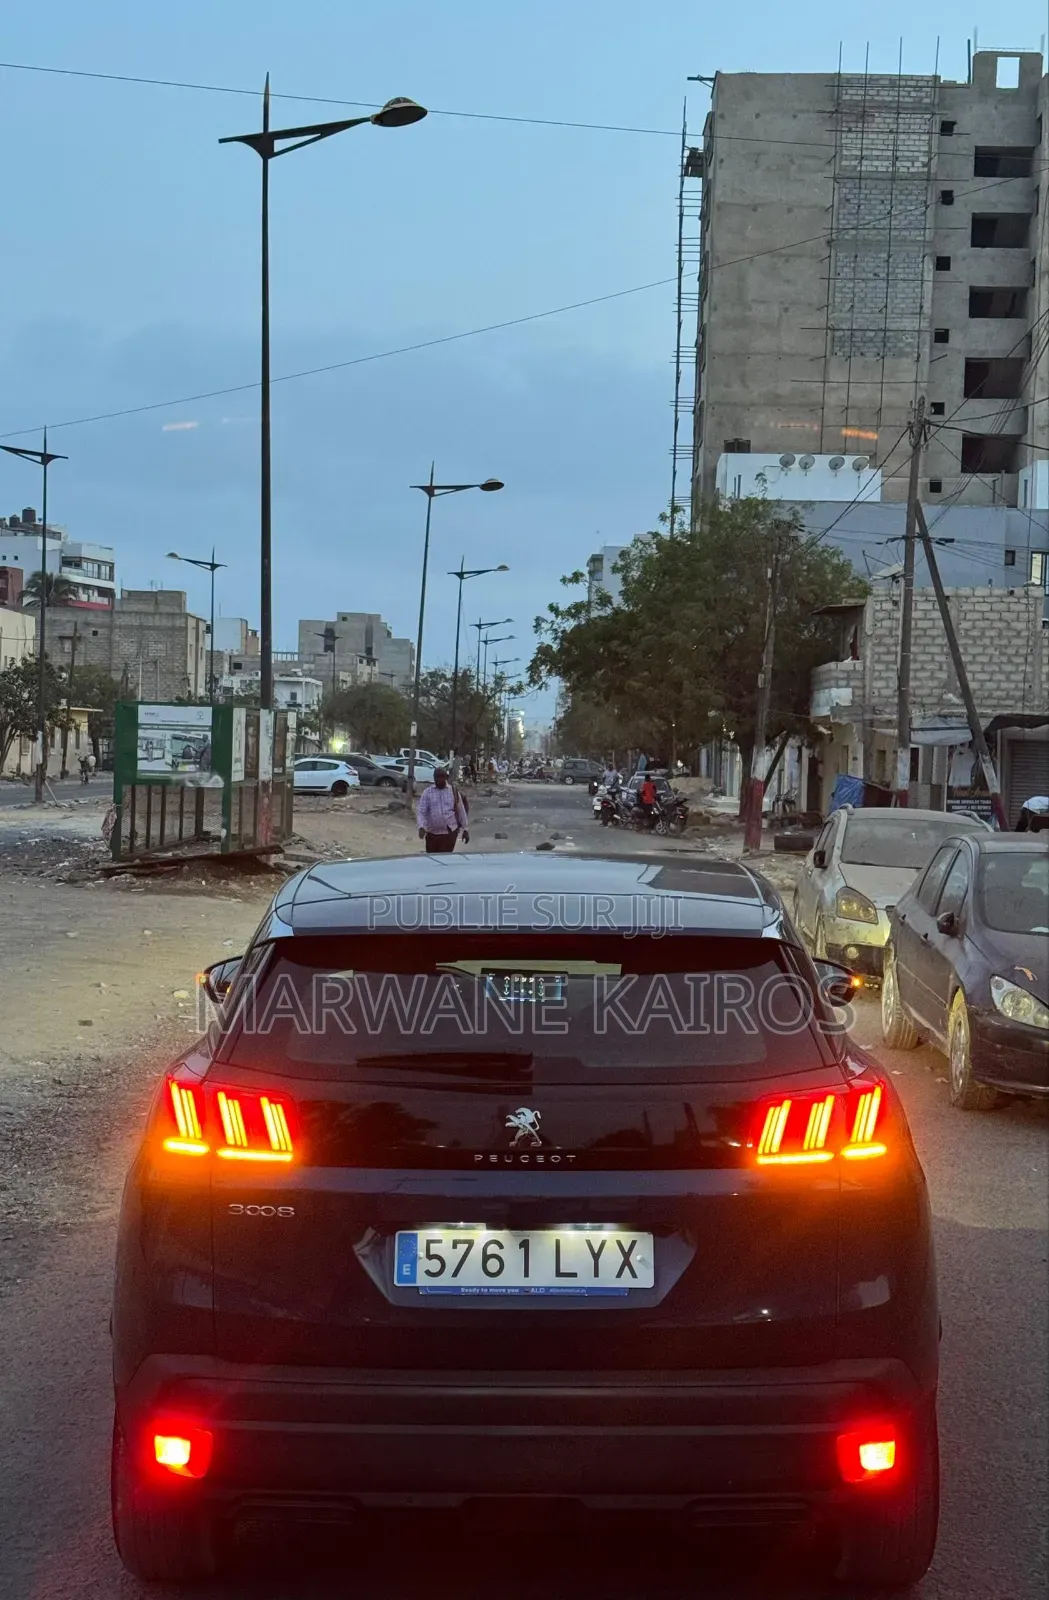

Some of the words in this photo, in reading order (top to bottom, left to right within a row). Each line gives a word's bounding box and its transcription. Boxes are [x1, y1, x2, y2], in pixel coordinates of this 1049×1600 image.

[474, 1154, 576, 1163] PEUGEOT
[228, 1204, 295, 1218] 3008
[424, 1238, 531, 1279] 5761
[554, 1238, 639, 1279] LYX
[402, 1263, 411, 1276] E
